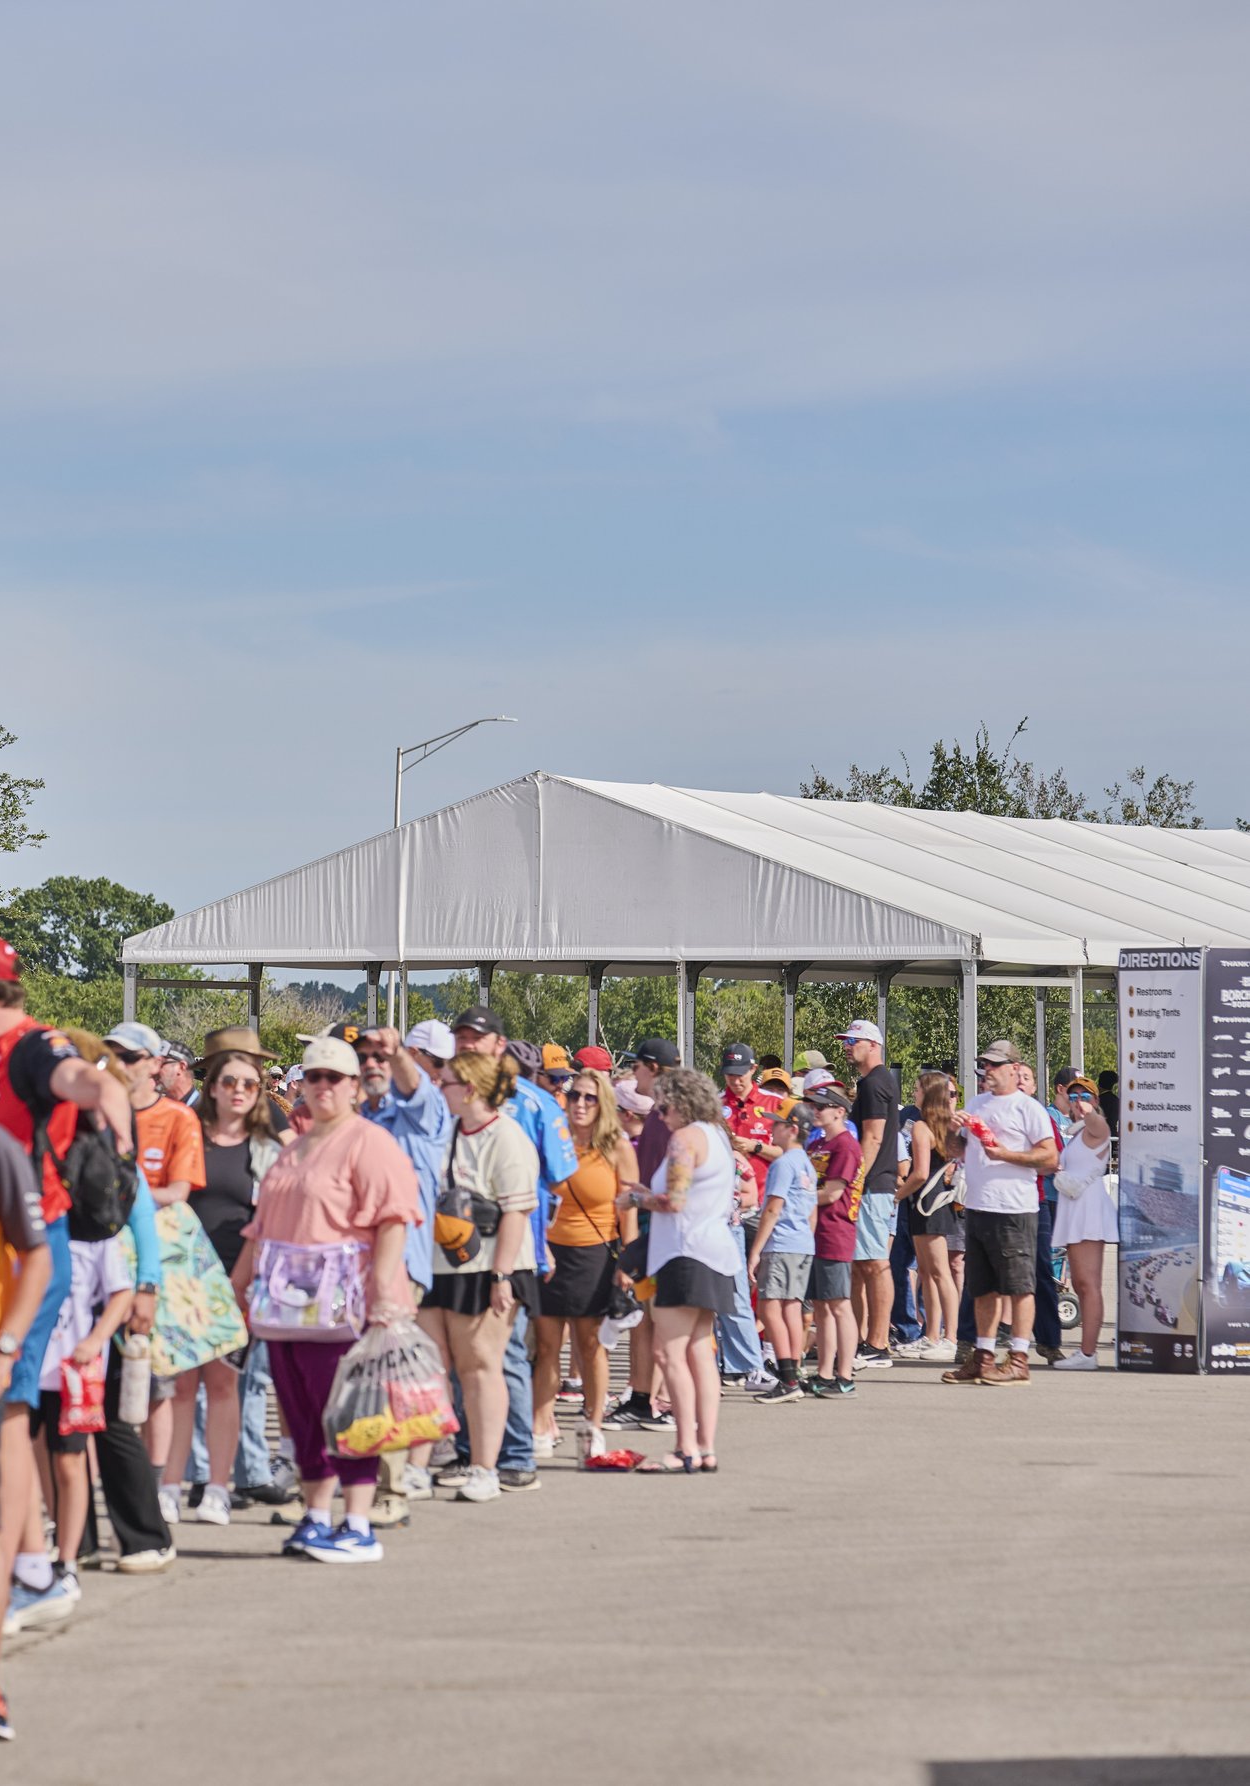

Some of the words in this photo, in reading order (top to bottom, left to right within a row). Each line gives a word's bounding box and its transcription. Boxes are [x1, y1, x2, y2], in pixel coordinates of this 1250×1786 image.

[1119, 952, 1201, 968] DIRECTIONS
[1136, 988, 1172, 996] Restrooms
[1137, 1009, 1160, 1019] Misting
[1162, 1008, 1180, 1017] Tents
[1137, 1030, 1156, 1040] Stage
[1137, 1050, 1176, 1059] Grandstand
[1137, 1061, 1167, 1069] Entrance
[1137, 1081, 1157, 1090] Infield
[1159, 1081, 1175, 1090] Tram
[1137, 1102, 1165, 1111] Paddock
[1167, 1103, 1191, 1112] Access
[1137, 1123, 1157, 1132] Ticket
[1159, 1123, 1178, 1132] Office
